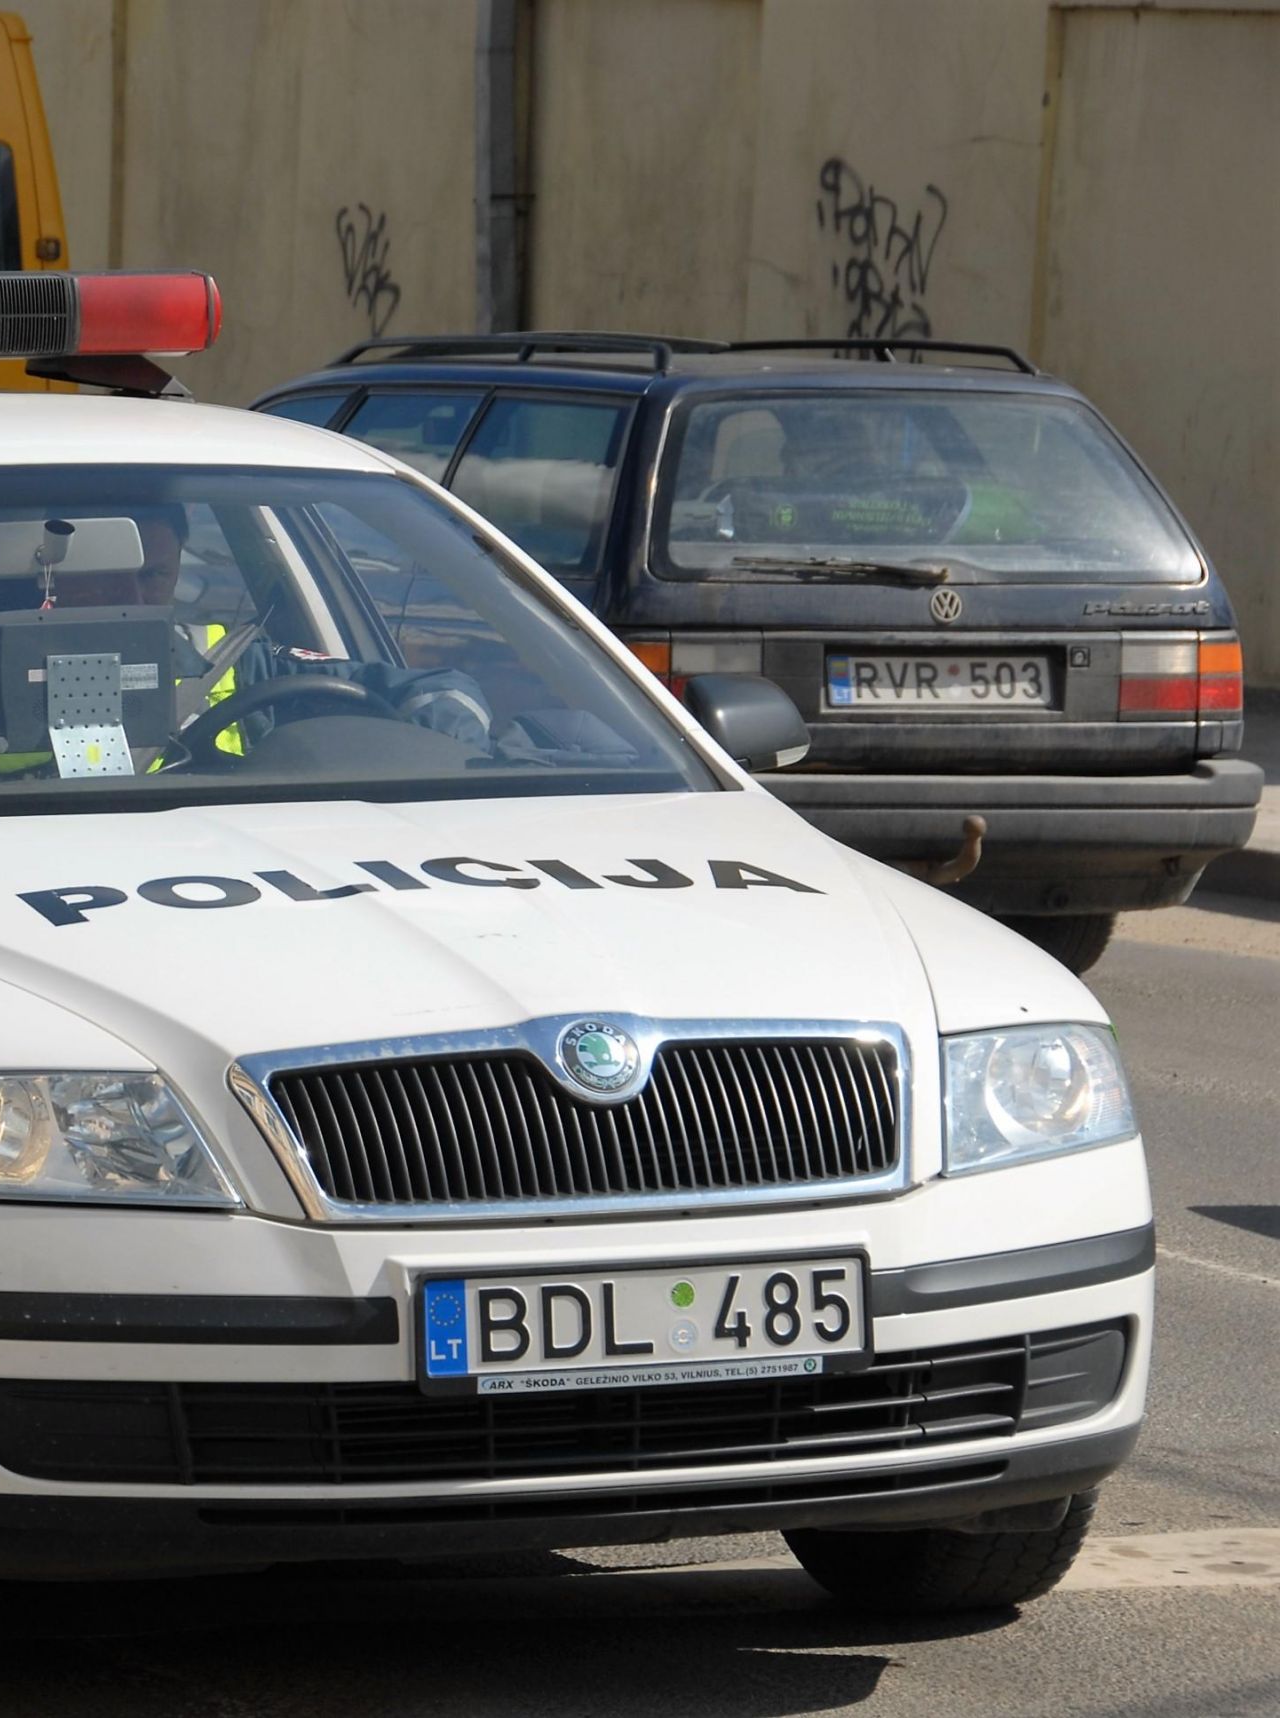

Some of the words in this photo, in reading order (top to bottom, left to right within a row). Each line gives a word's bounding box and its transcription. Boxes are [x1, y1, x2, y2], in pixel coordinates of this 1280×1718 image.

[854, 661, 940, 699] RVR
[970, 661, 1043, 699] 503
[15, 857, 828, 927] POLICIJA
[478, 1281, 654, 1363] BDL
[714, 1268, 850, 1347] 485
[430, 1338, 462, 1361] LT
[489, 1380, 514, 1390] ARX
[576, 1374, 630, 1386] GELEŽINIO
[632, 1372, 661, 1383] VILKO
[664, 1371, 678, 1382] 53,
[681, 1368, 723, 1380] VILNIUS,
